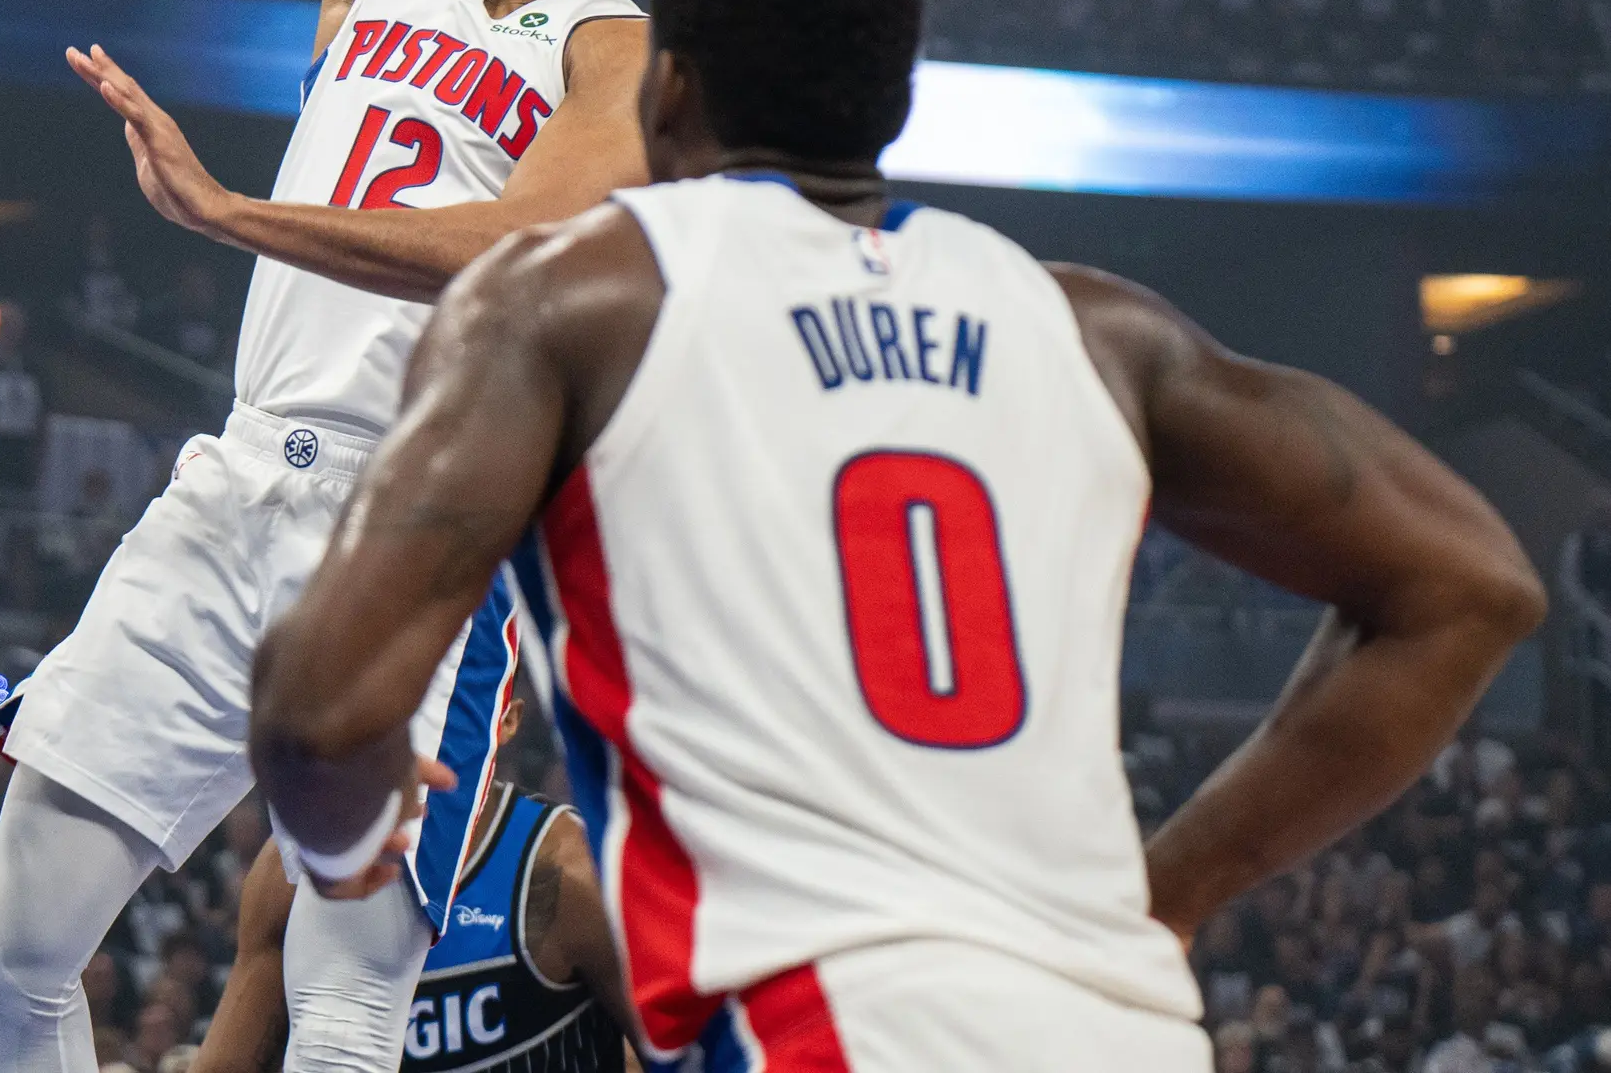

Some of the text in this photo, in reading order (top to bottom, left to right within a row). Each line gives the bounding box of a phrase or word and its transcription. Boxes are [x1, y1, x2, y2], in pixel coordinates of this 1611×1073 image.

[489, 24, 557, 46] StockX
[335, 19, 553, 161] PISTONS
[329, 104, 443, 210] 12
[788, 297, 989, 398] DUREN
[830, 443, 1029, 752] 0
[454, 904, 506, 930] Disney
[403, 982, 507, 1061] GIC
